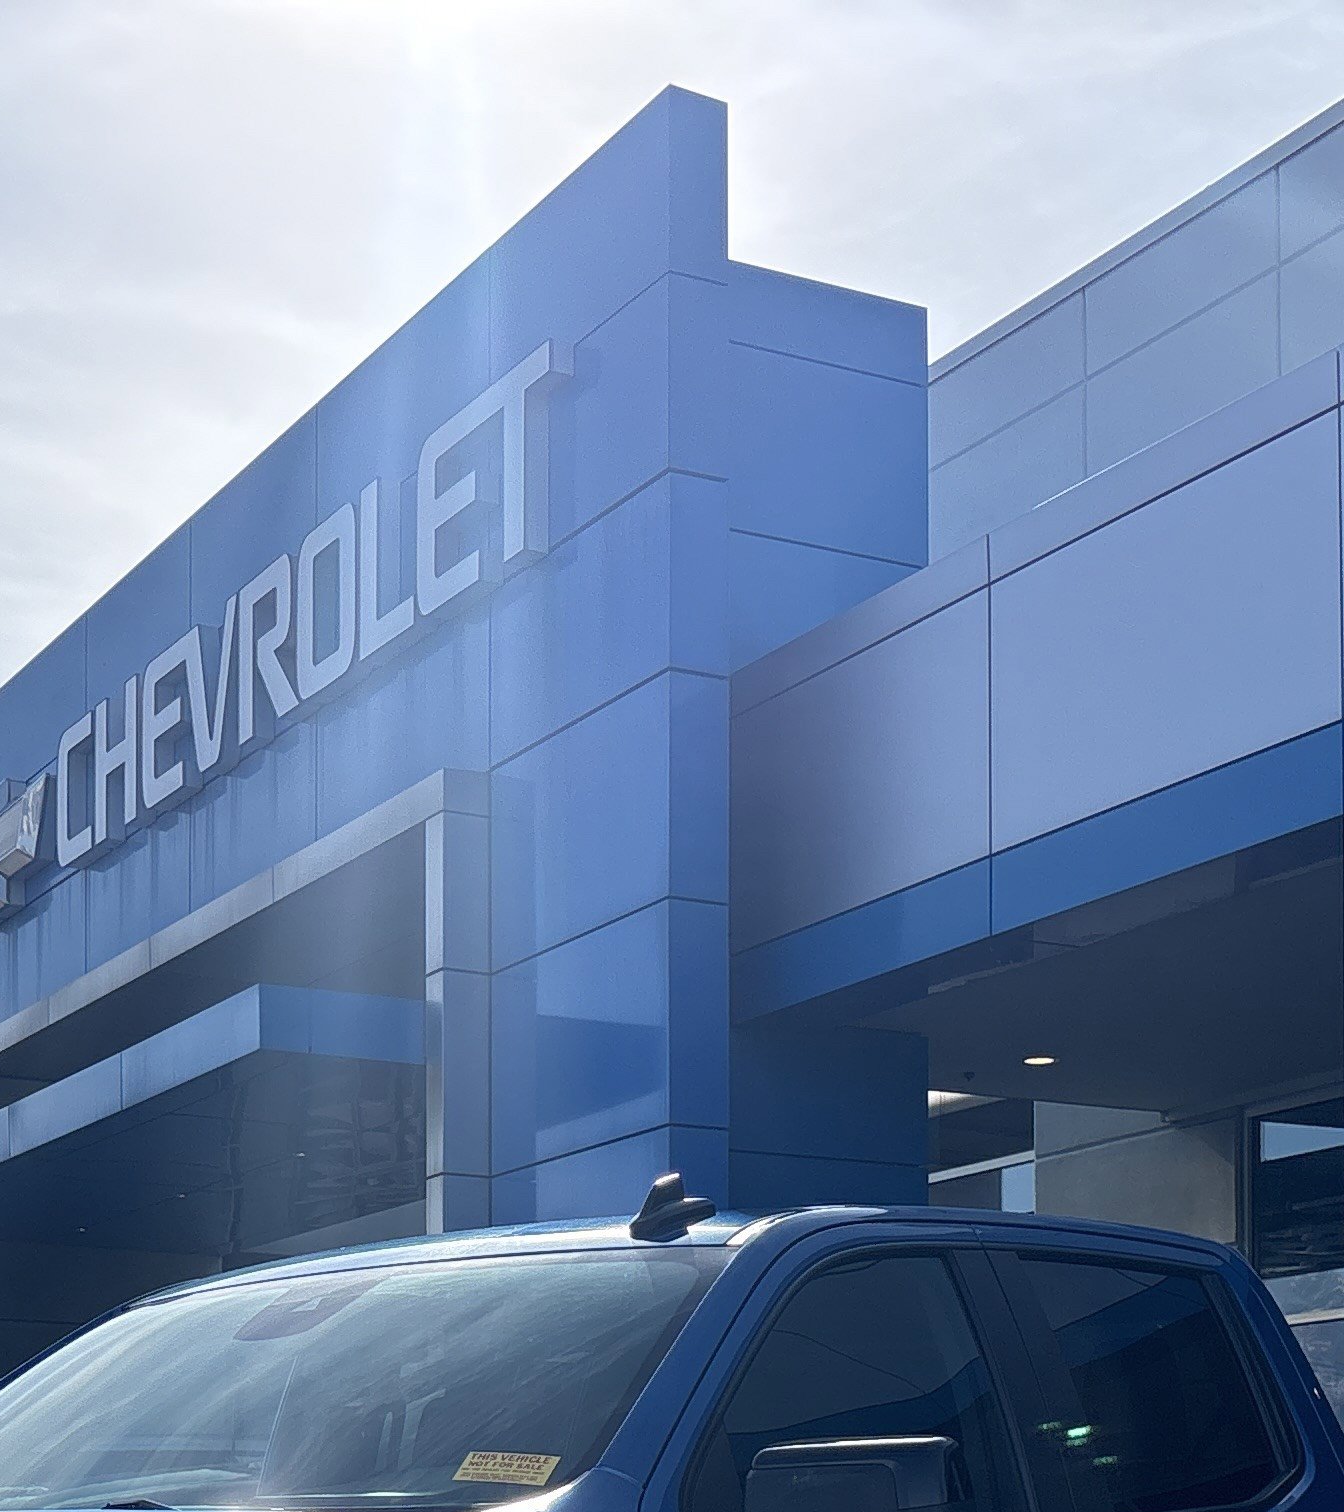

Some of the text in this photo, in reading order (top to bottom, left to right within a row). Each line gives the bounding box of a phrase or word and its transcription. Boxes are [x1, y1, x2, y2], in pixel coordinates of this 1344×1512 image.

[56, 339, 552, 869] CHEVROLET
[470, 1453, 552, 1465] THIS VEHICLE
[492, 1461, 514, 1469] FOR
[516, 1463, 544, 1471] SALE
